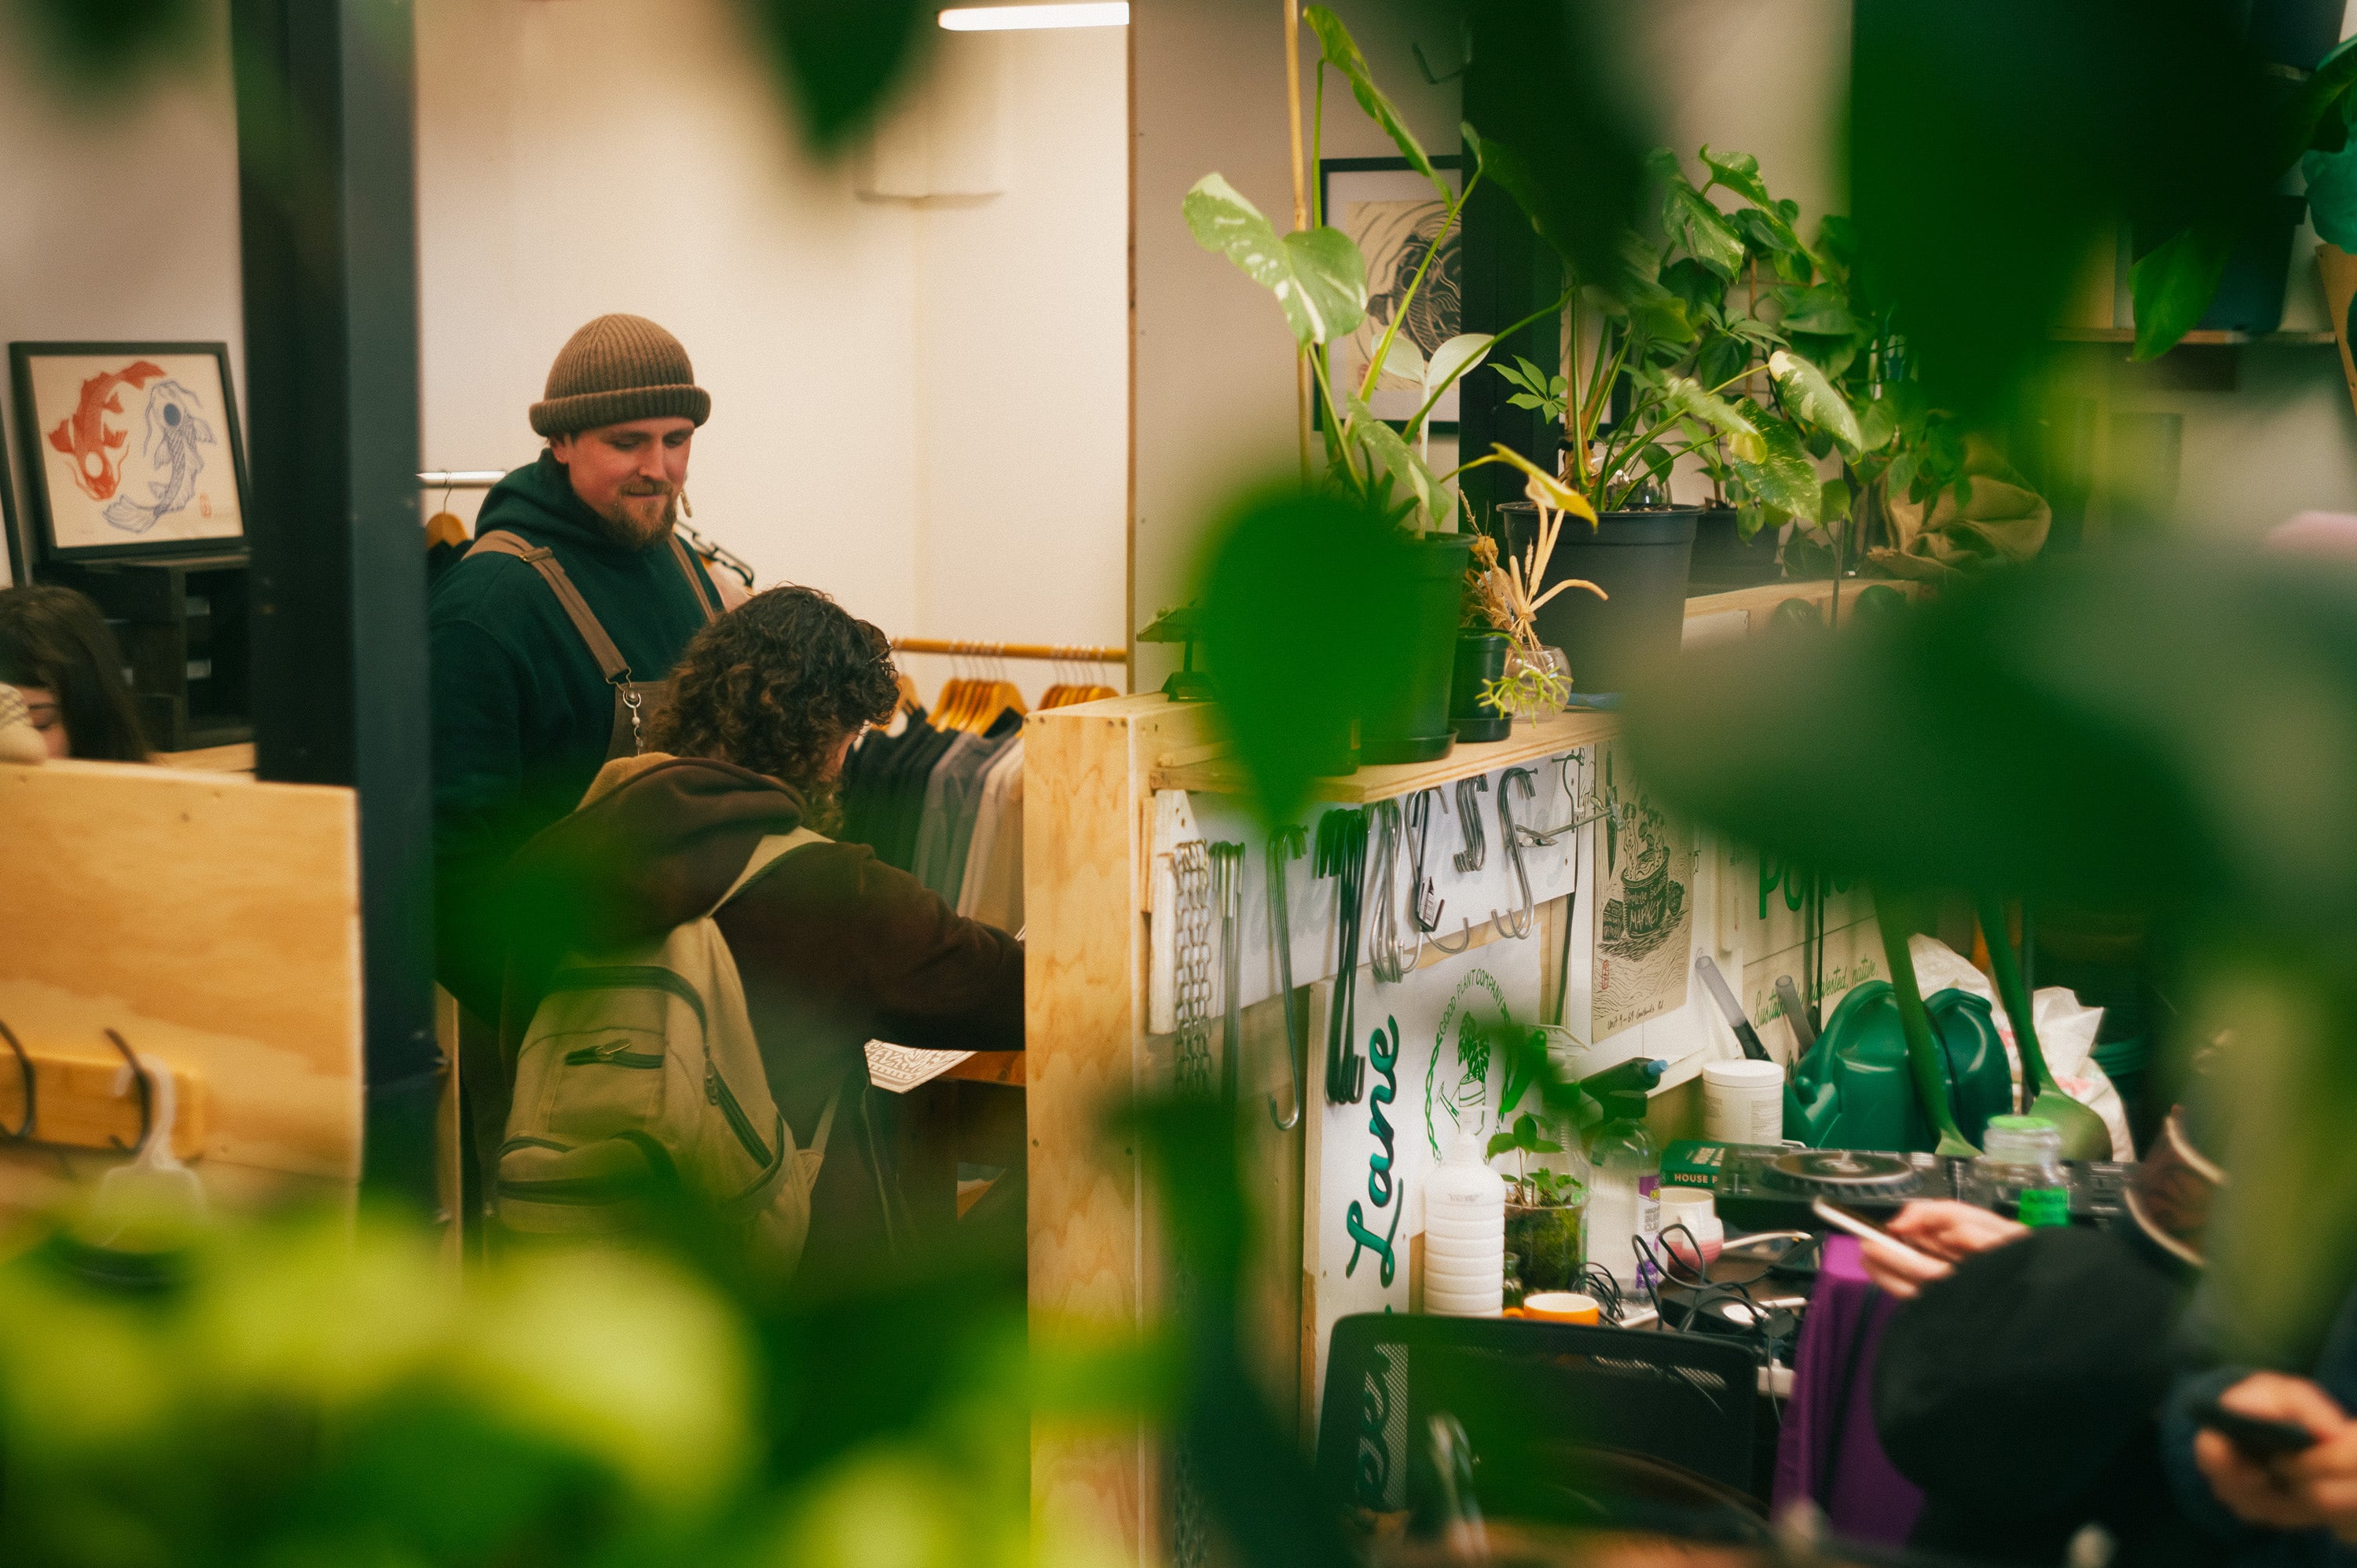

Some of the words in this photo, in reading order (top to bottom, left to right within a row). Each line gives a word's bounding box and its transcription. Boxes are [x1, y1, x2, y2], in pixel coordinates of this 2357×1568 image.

[1439, 995, 1456, 1035] GOOD
[1457, 969, 1475, 1000] PLANT
[1476, 968, 1505, 1007] COMPANY
[1346, 1013, 1404, 1288] Lane
[1674, 1174, 1709, 1184] HOUSE
